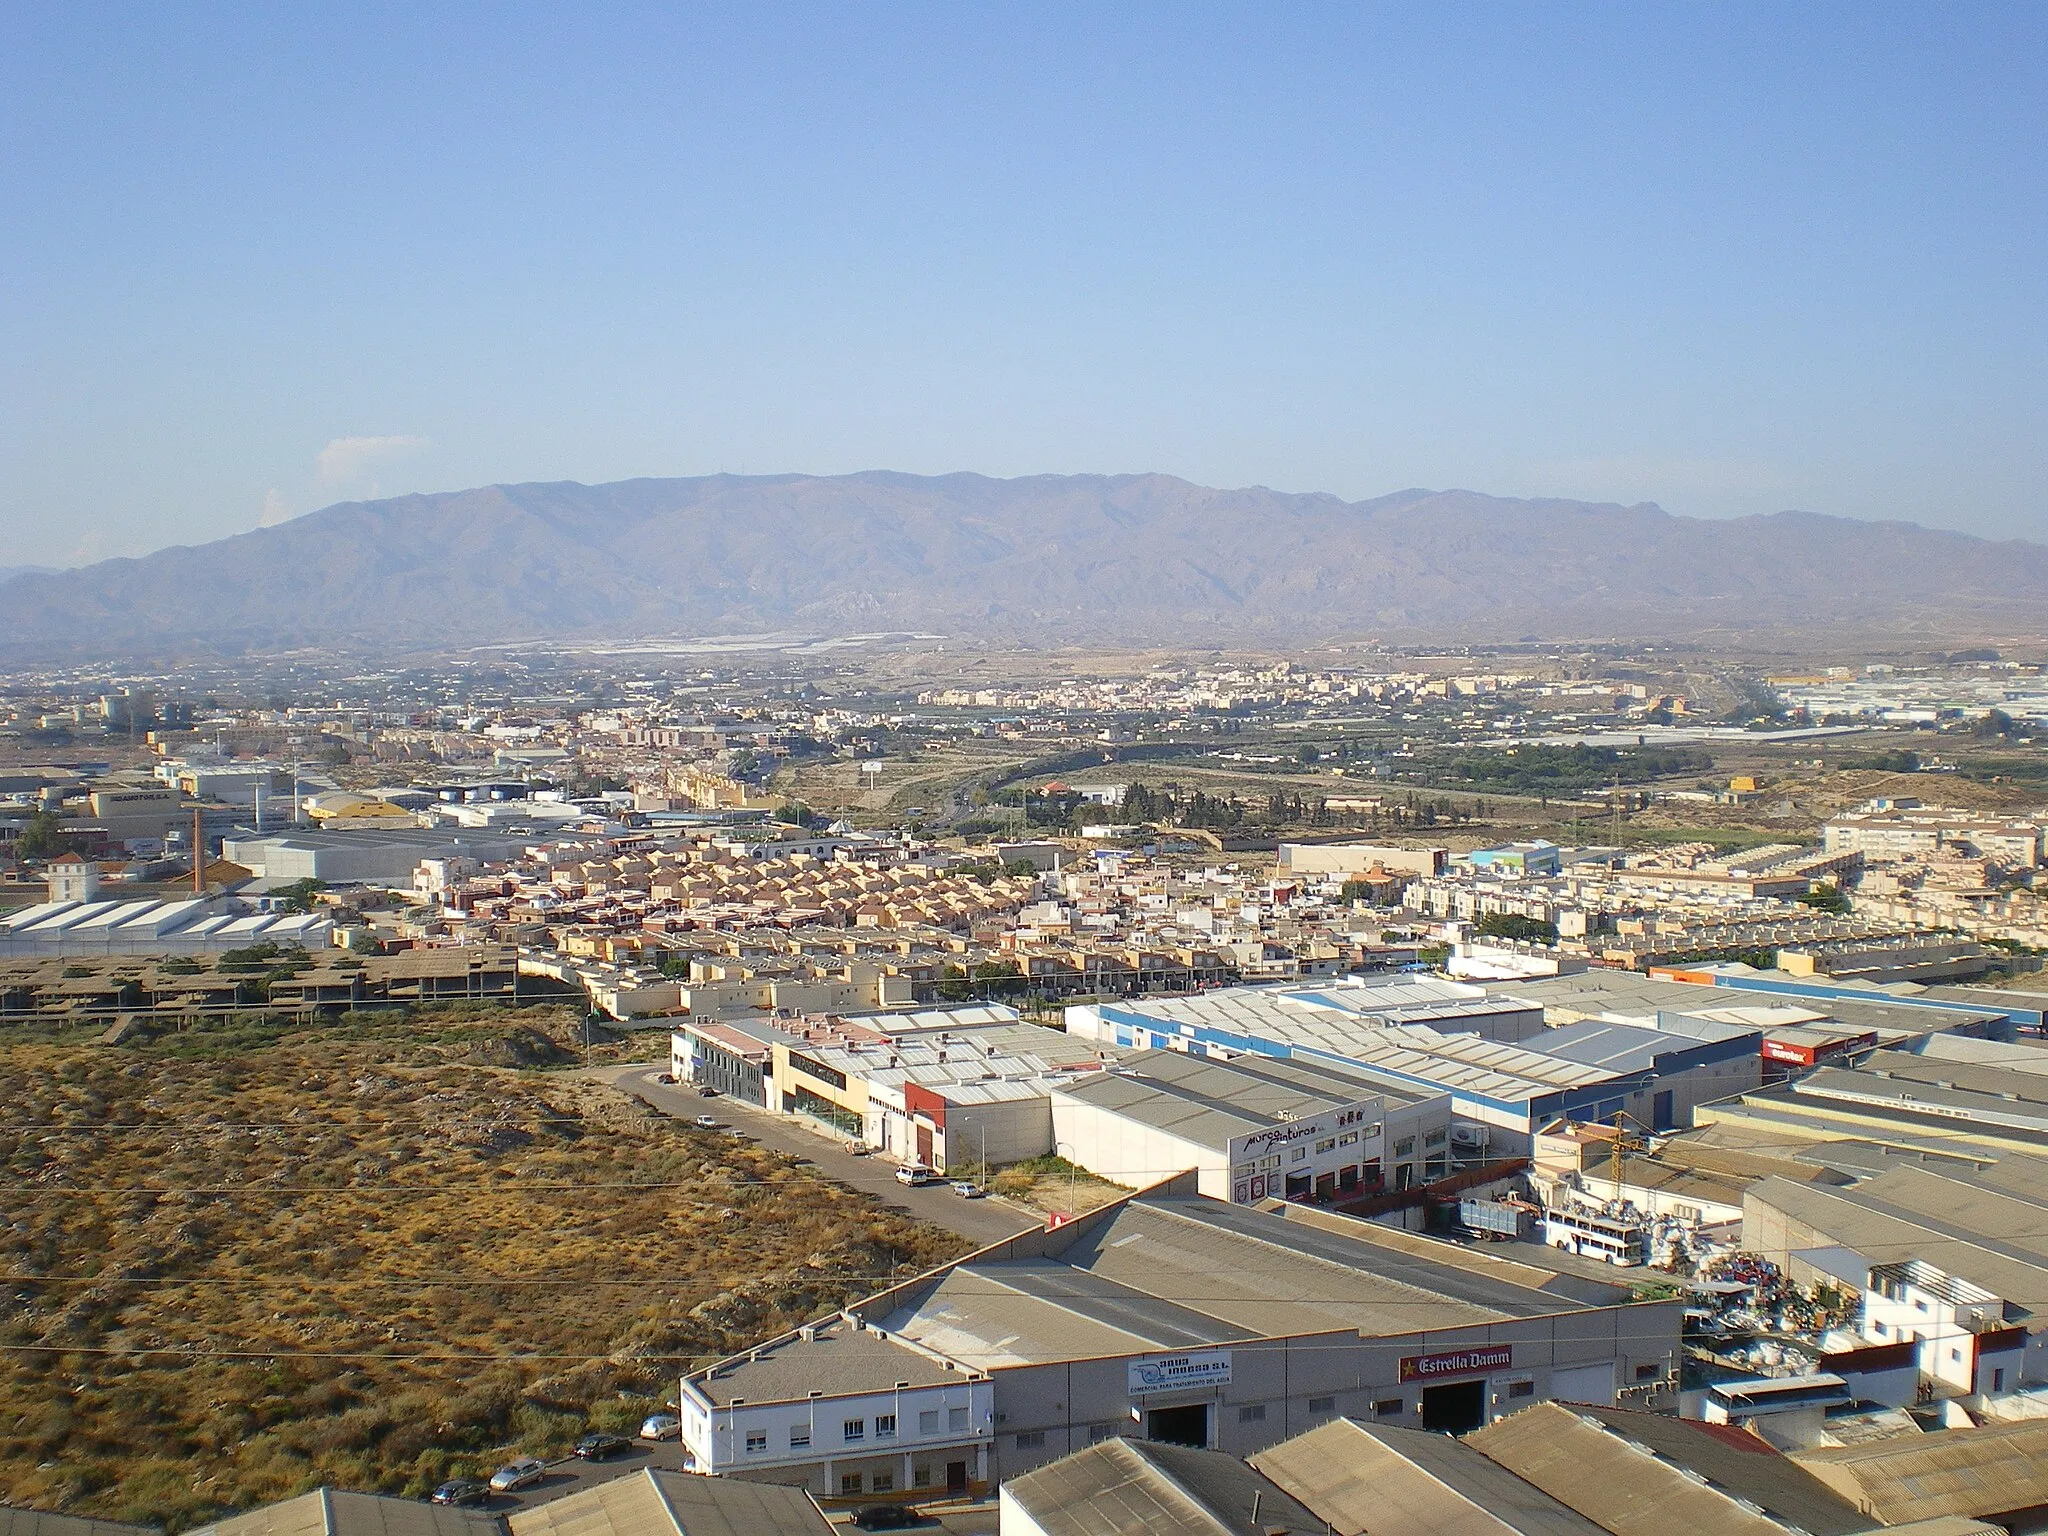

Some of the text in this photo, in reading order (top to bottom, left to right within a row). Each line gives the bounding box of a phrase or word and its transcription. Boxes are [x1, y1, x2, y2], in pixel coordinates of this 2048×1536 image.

[1772, 1049, 1805, 1062] eurotex
[1265, 1126, 1316, 1153] Pinturas
[1418, 1353, 1509, 1374] Estrella Damm
[1130, 1386, 1158, 1394] COMERCIAL
[1173, 1379, 1205, 1388] TRATAMIENTO
